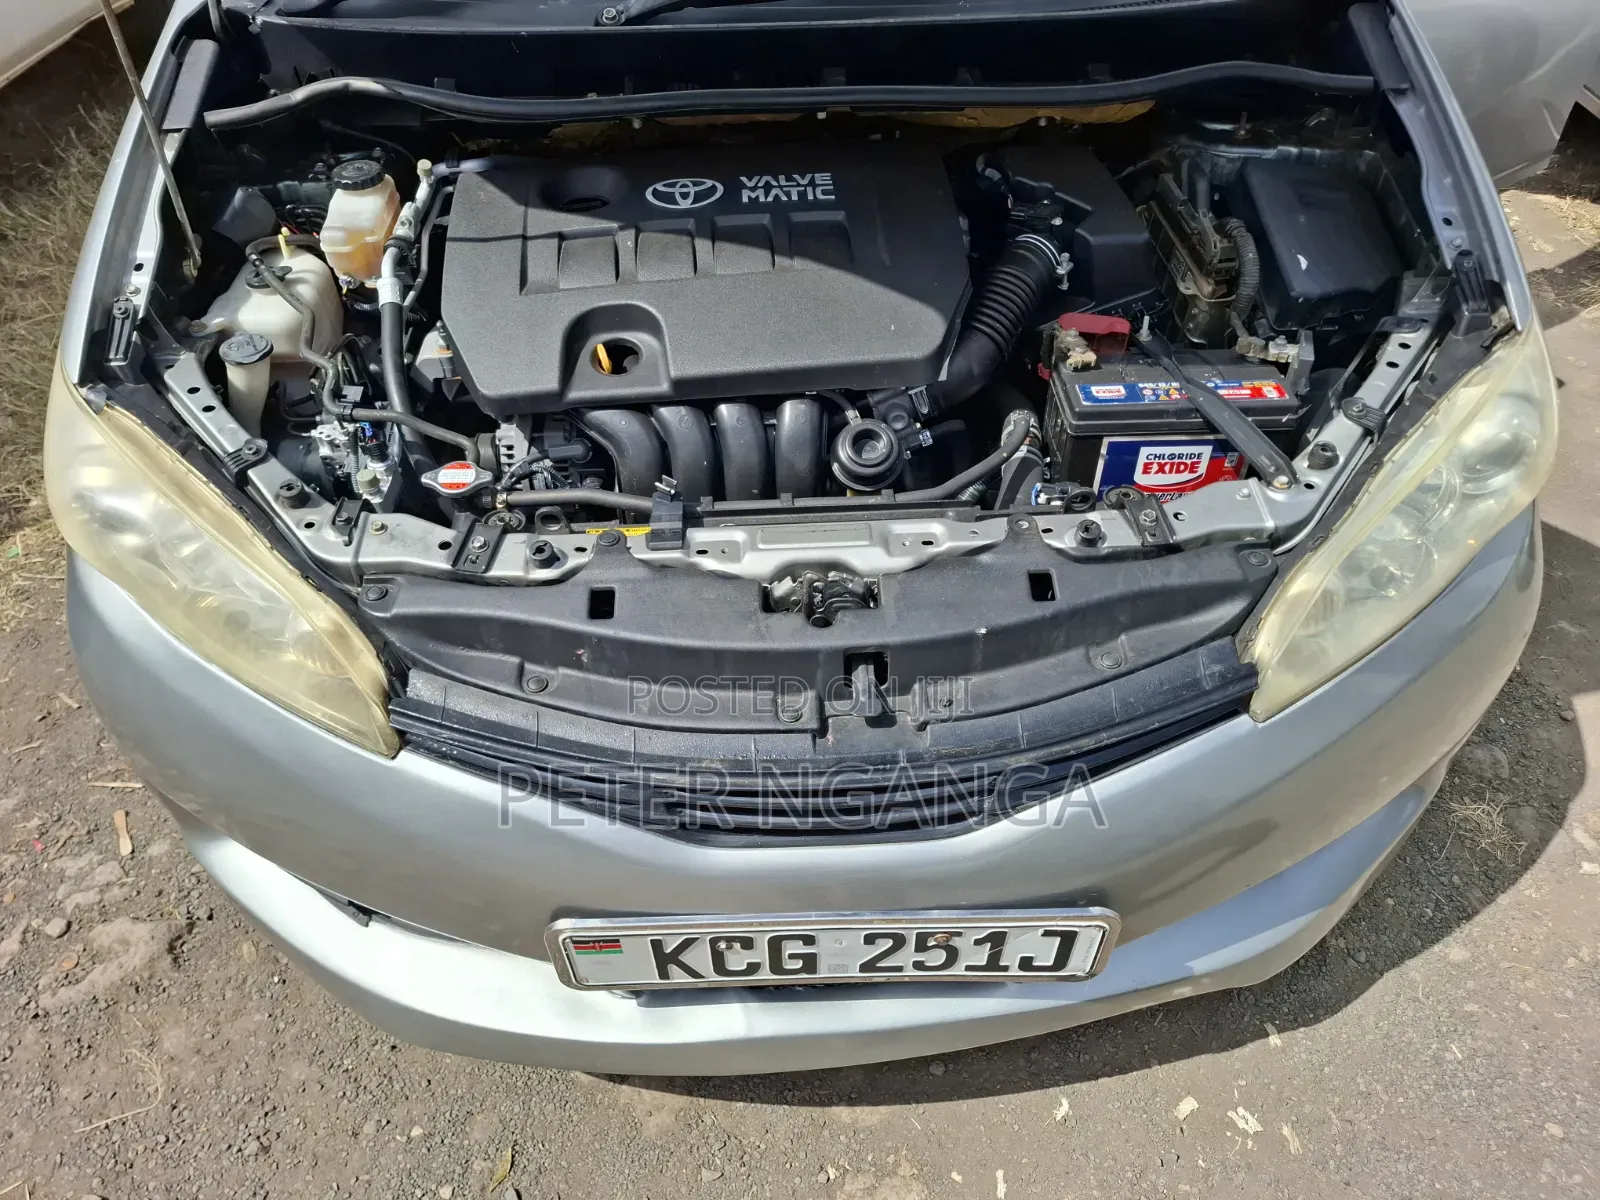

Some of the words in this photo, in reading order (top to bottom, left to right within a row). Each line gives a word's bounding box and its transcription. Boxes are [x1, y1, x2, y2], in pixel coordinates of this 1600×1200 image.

[739, 172, 833, 187] VALVE
[741, 186, 836, 203] MATIC
[1145, 451, 1204, 461] CHLORIDE
[1141, 460, 1202, 475] EXIDE
[649, 933, 818, 981] KCG
[858, 929, 1079, 974] 251J
